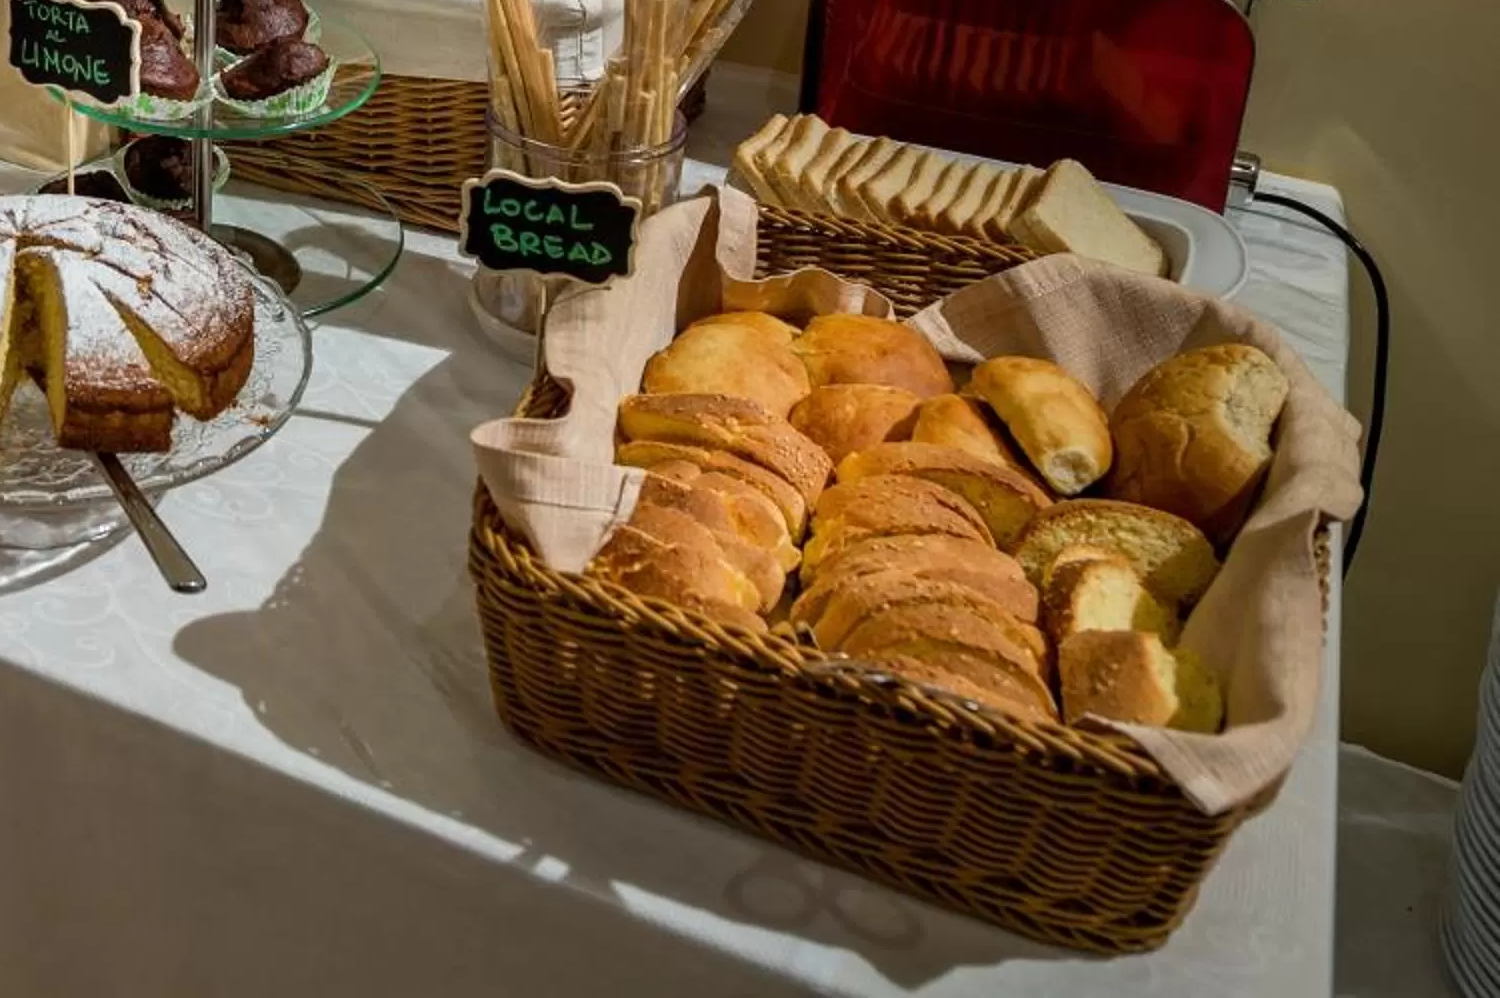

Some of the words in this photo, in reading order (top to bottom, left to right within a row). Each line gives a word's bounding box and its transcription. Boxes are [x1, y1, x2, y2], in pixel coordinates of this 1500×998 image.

[23, 0, 91, 34] TORTA
[45, 29, 68, 44] AL
[21, 38, 111, 85] LIMONE
[483, 188, 594, 231] LOCAL
[489, 223, 613, 266] BREAD
